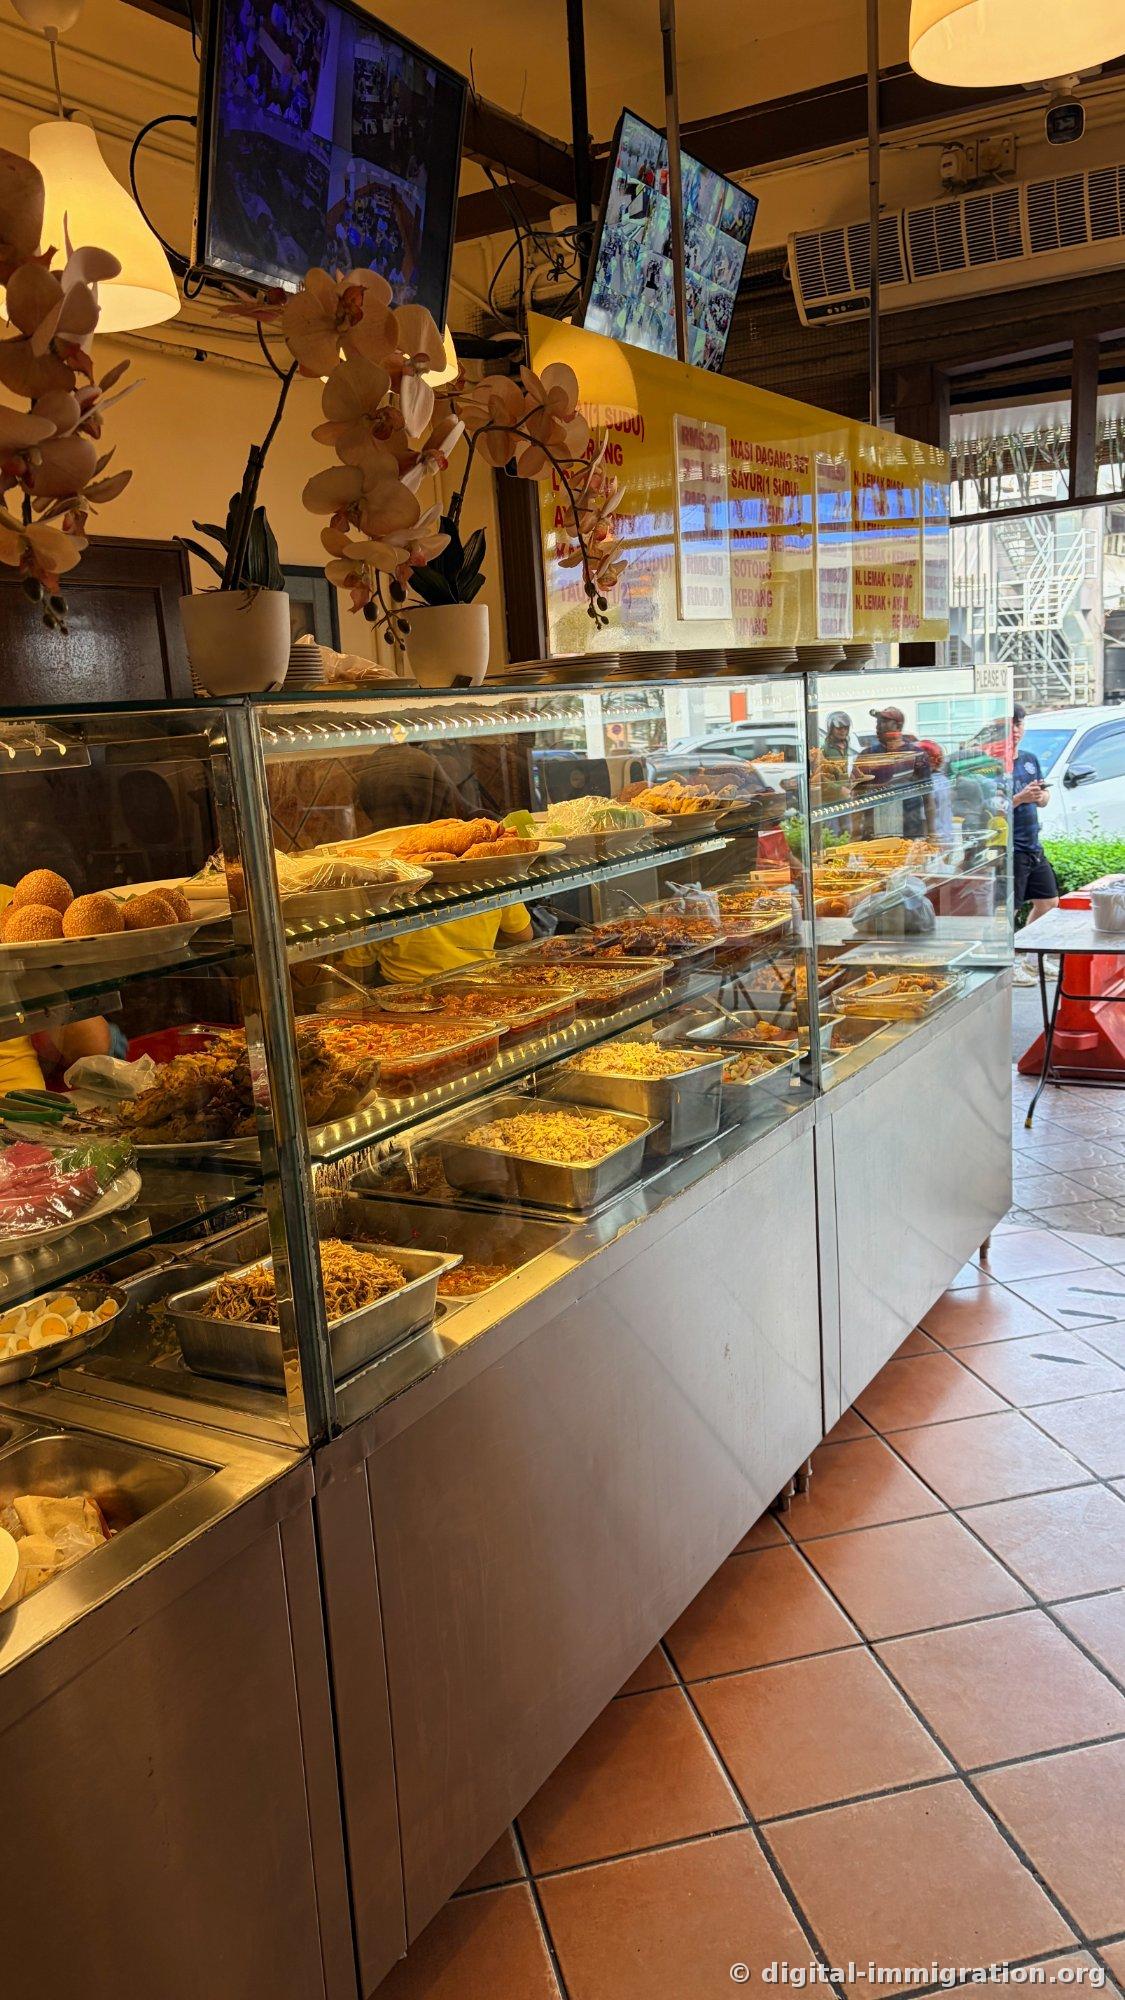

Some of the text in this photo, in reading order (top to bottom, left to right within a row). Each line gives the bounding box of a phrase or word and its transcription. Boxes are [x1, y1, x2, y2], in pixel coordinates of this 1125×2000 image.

[730, 438, 753, 462] NASI
[755, 445, 792, 471] DAGANG
[731, 469, 771, 498] SAYUR(1
[733, 558, 773, 580] SOTONG
[855, 570, 863, 586] N.
[863, 570, 887, 587] LEMAK
[892, 573, 913, 589] UDANG
[735, 588, 773, 608] KERANG
[855, 595, 863, 610] N.
[863, 595, 887, 610] LEMAK
[892, 596, 909, 611] AYAM
[976, 669, 999, 688] PLEASE
